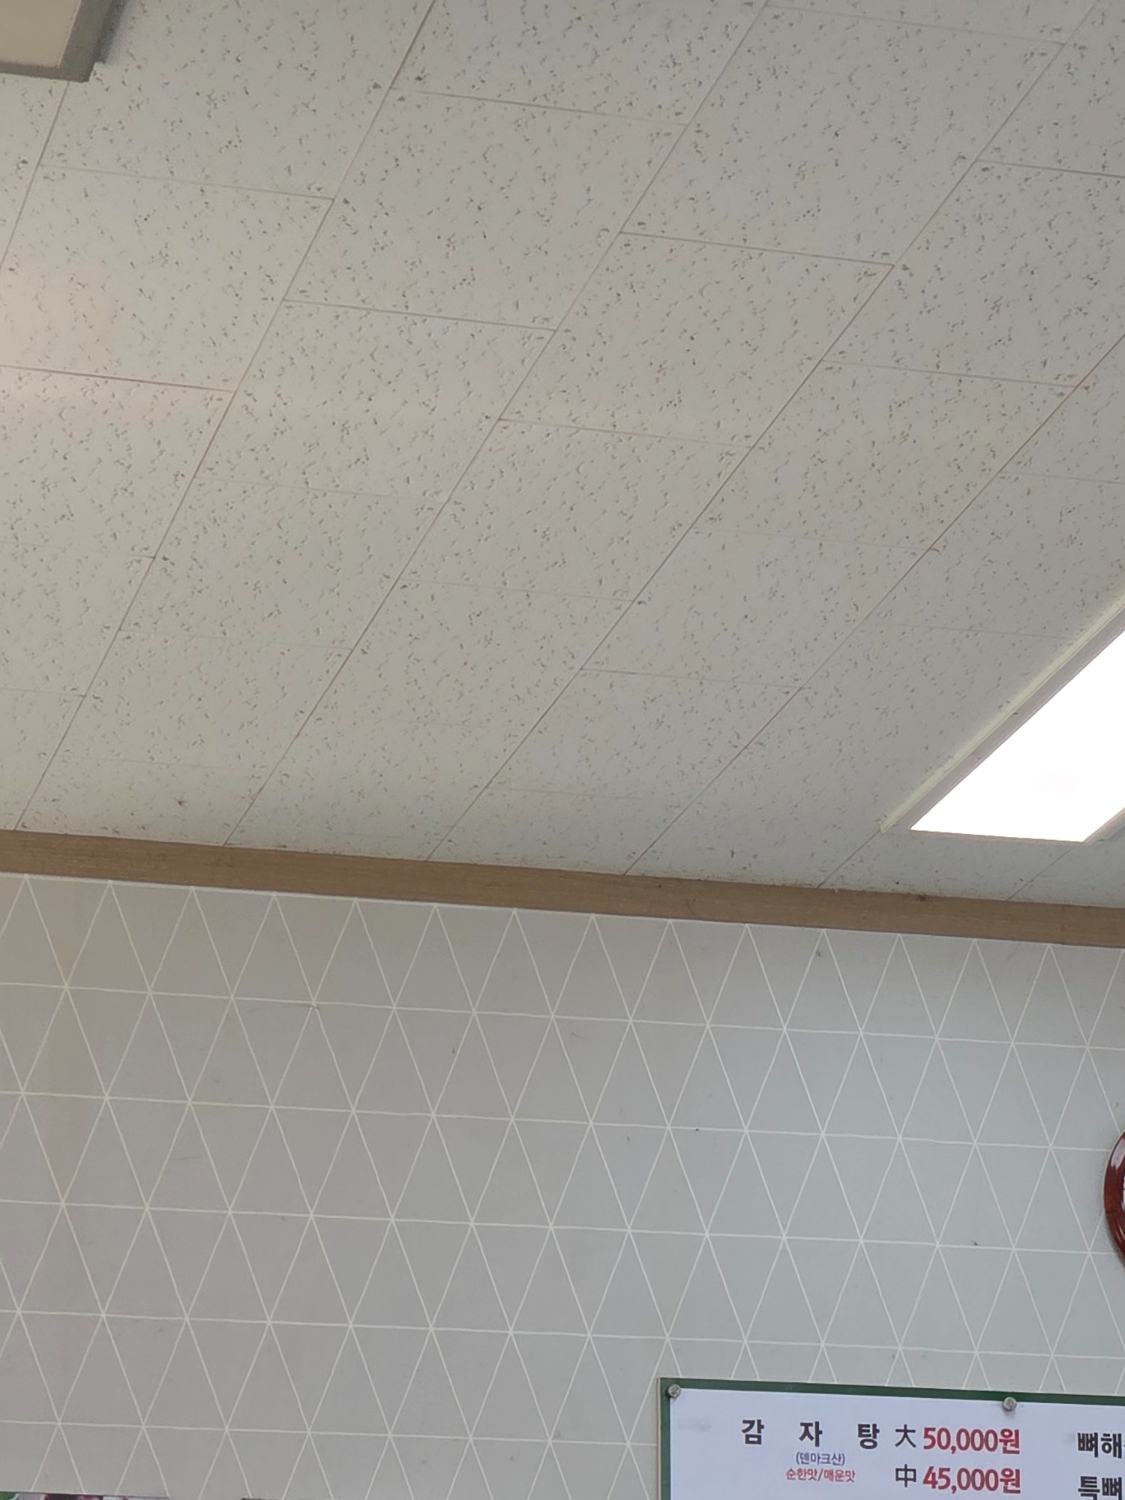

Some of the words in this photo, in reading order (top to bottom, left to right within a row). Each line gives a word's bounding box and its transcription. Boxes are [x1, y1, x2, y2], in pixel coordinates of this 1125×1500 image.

[741, 1419, 765, 1445] 감
[799, 1421, 822, 1447] 자
[858, 1423, 880, 1449] 탕
[895, 1424, 917, 1449] 大
[923, 1427, 1020, 1455] 50,000원
[796, 1452, 846, 1467] (덴마크산)
[786, 1468, 856, 1483] 순한맛/매운맛
[895, 1463, 917, 1488] 中
[922, 1466, 1021, 1494] 45,000원
